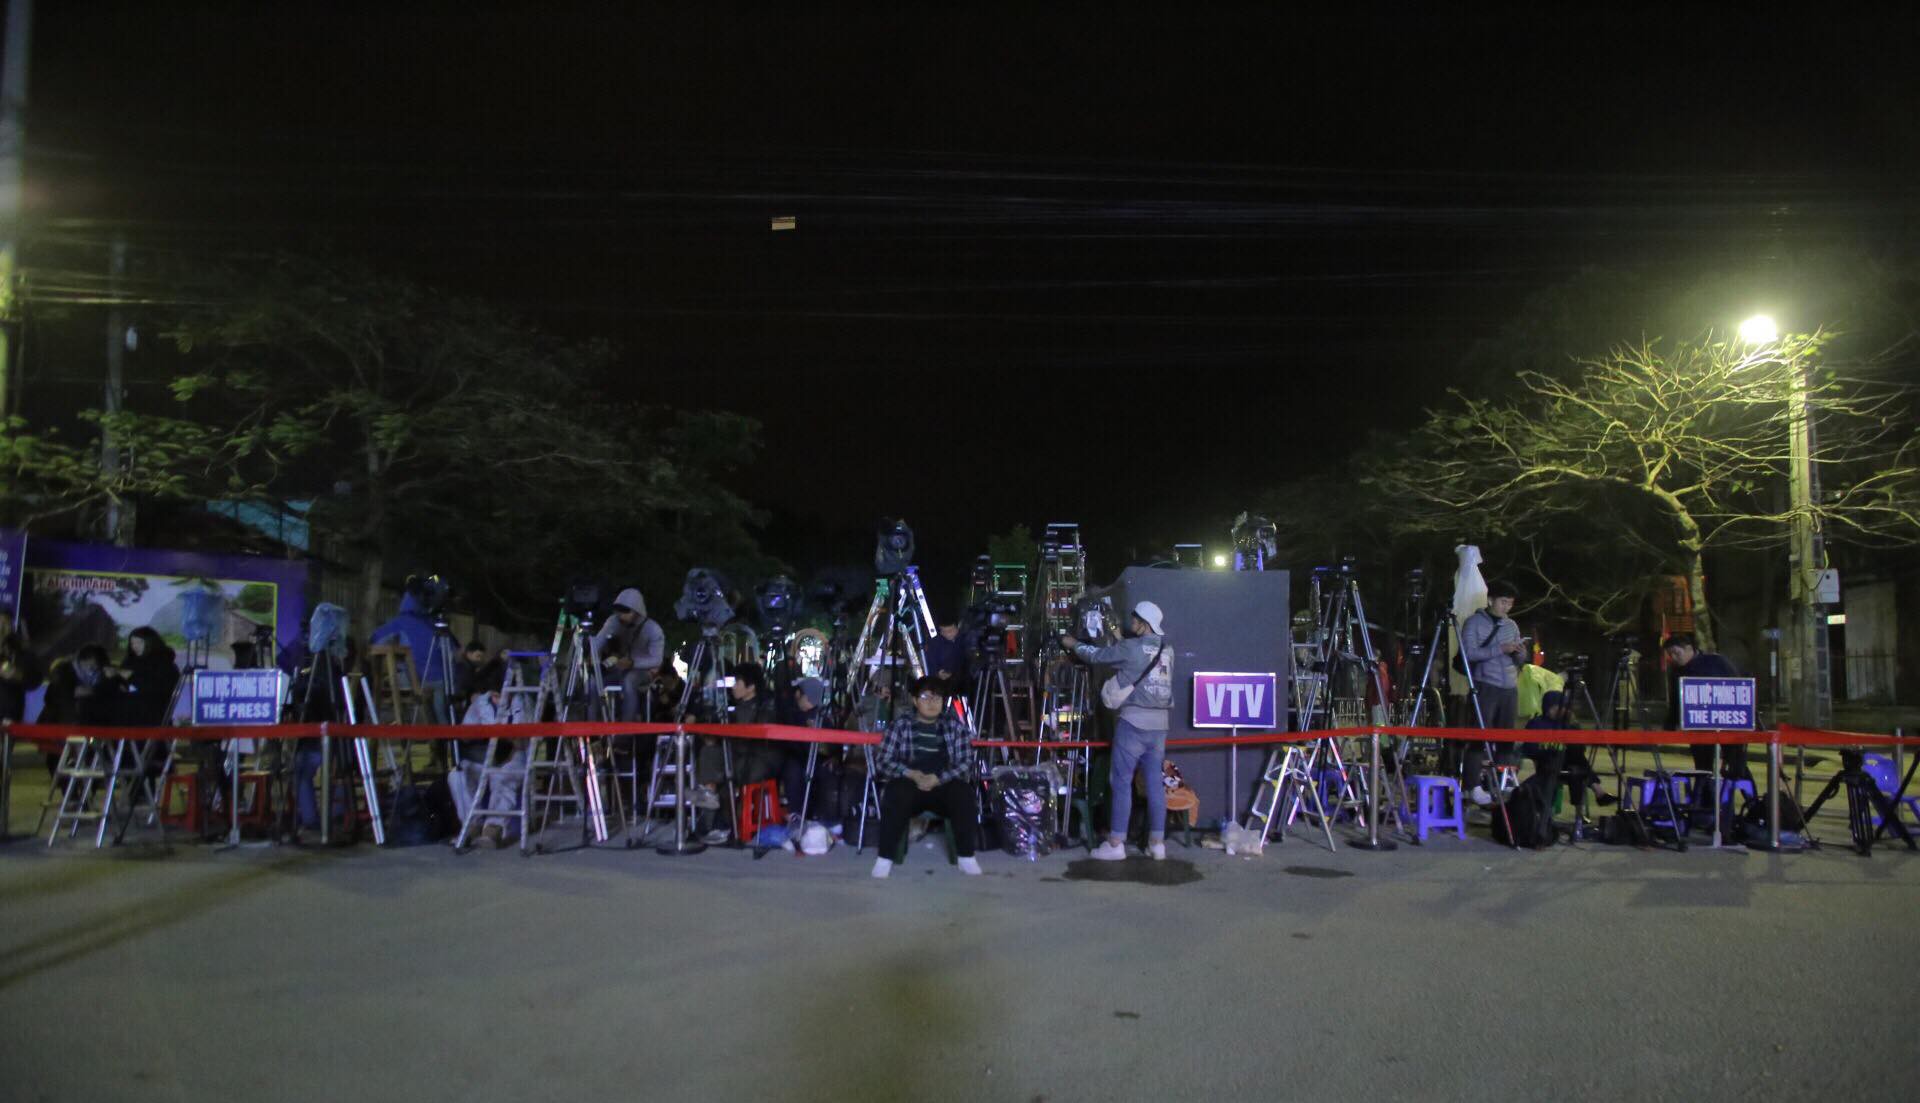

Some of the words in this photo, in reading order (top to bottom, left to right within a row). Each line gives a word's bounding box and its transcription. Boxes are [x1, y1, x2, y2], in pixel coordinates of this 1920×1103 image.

[1205, 683, 1265, 718] VTV
[202, 703, 226, 719] THE
[228, 702, 271, 719] PRESS
[1688, 710, 1709, 724] THE
[1710, 710, 1747, 725] PRESS
